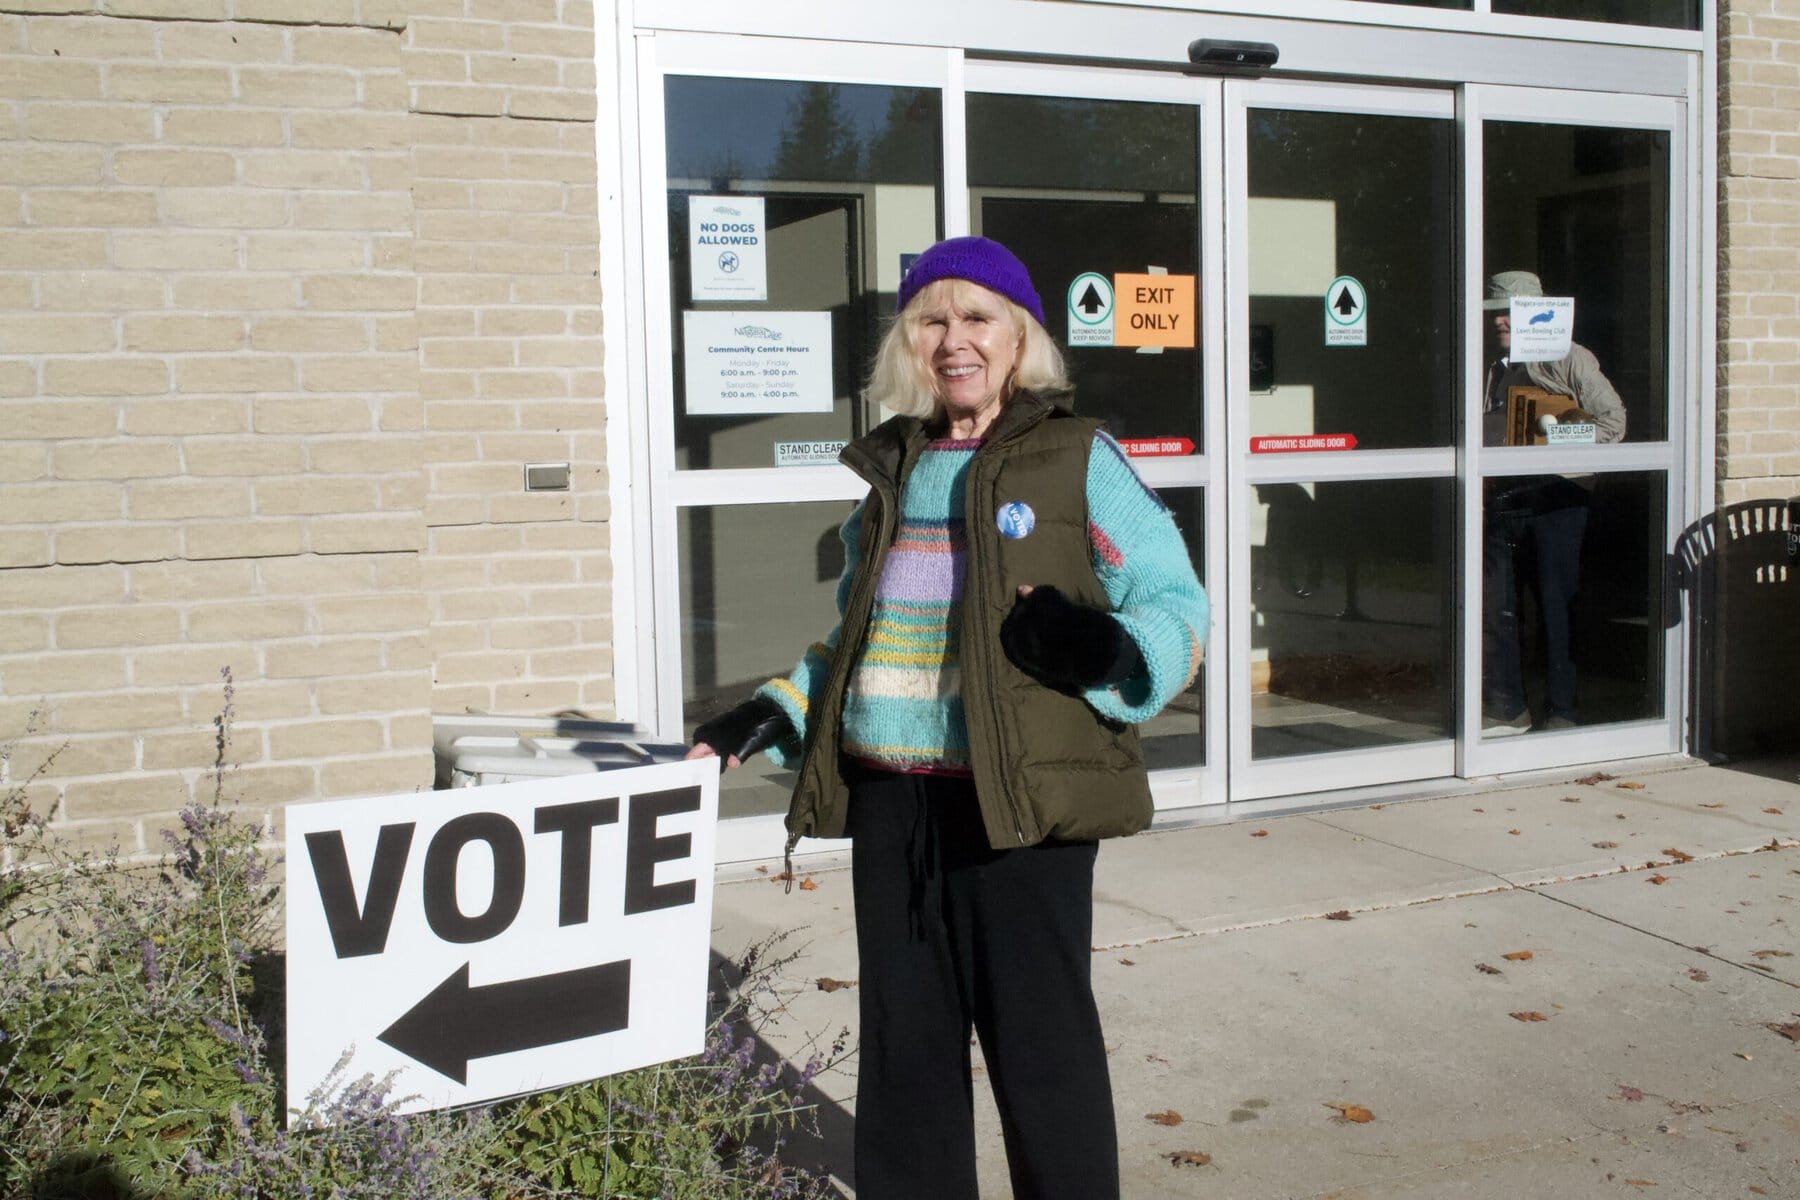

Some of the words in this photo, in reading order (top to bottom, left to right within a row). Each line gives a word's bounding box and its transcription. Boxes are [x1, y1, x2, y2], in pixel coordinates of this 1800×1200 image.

[701, 223, 718, 232] NO
[722, 224, 755, 233] DOGS
[698, 236, 758, 245] ALLOWED
[1136, 287, 1174, 304] EXIT
[1130, 313, 1179, 330] ONLY
[708, 346, 755, 354] Community
[729, 360, 760, 368] Monday
[766, 360, 790, 368] Friday
[781, 369, 799, 377] p.m.
[726, 381, 760, 389] Saturday
[765, 381, 794, 389] Sunday
[782, 391, 800, 399] p.m.
[1551, 426, 1571, 435] STAND
[1573, 425, 1594, 434] CLEAR
[780, 444, 811, 455] STAND
[813, 443, 843, 454] CLEAR
[1131, 443, 1160, 453] SLIDING
[1161, 442, 1182, 452] DOOR
[1259, 440, 1297, 450] AUTOMATIC
[1299, 439, 1325, 448] SLIDING
[1327, 438, 1346, 448] DOOR
[304, 784, 702, 960] VOTE
